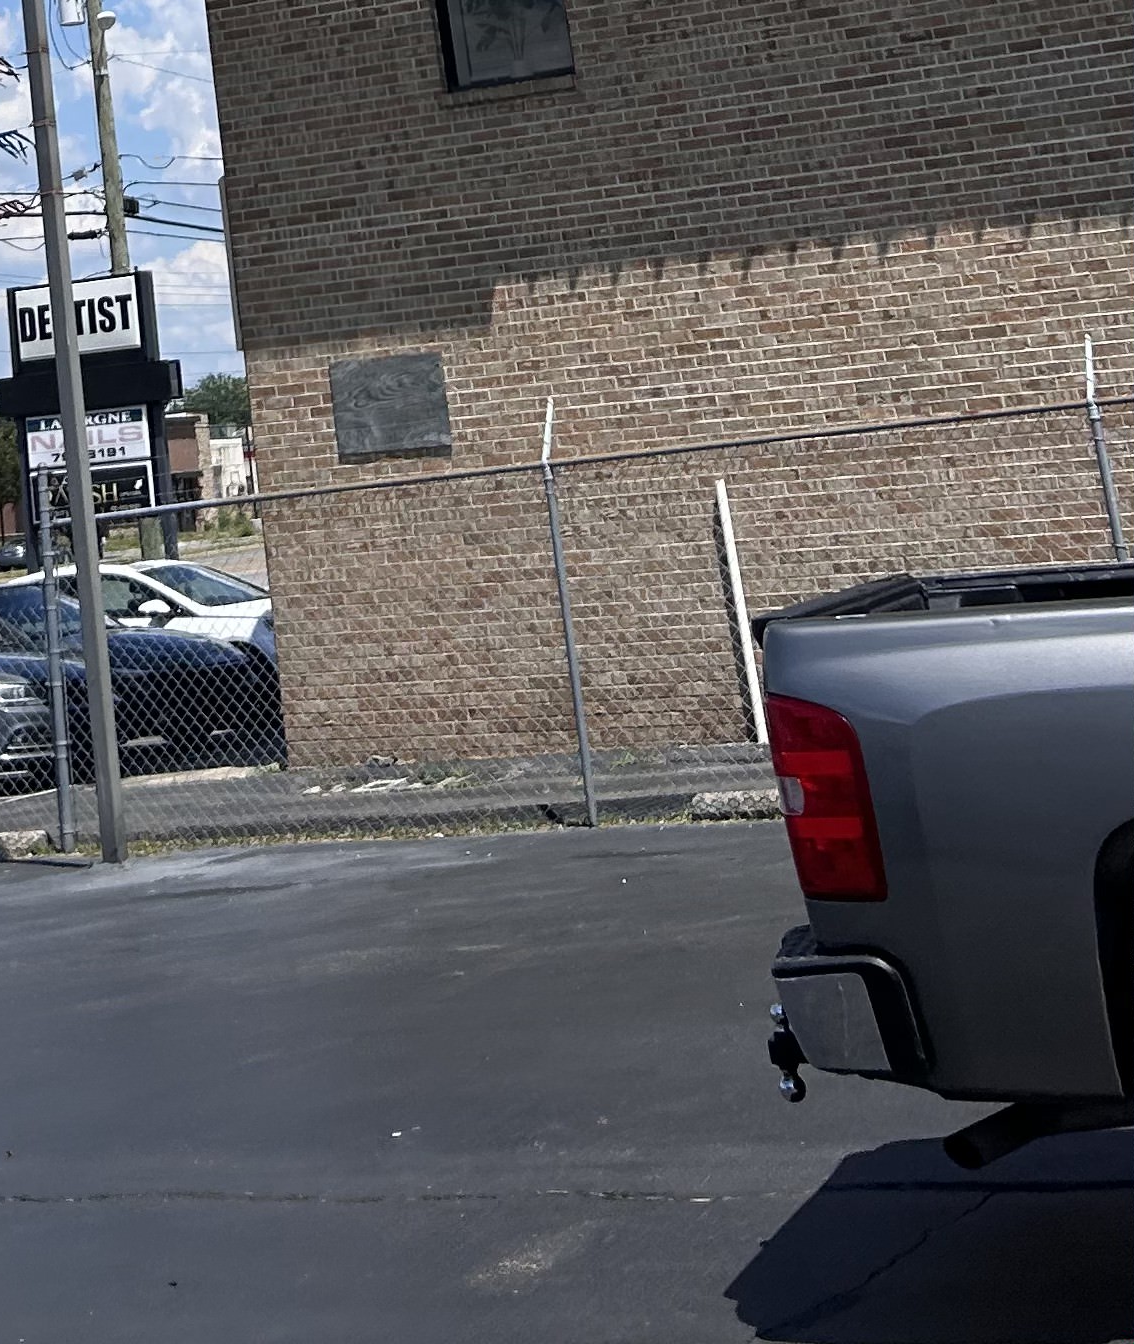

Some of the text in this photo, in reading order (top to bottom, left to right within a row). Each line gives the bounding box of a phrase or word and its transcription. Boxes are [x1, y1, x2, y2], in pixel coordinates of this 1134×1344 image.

[18, 293, 132, 342] DETIST
[39, 410, 132, 431] LARGNE
[30, 425, 144, 452] NILS
